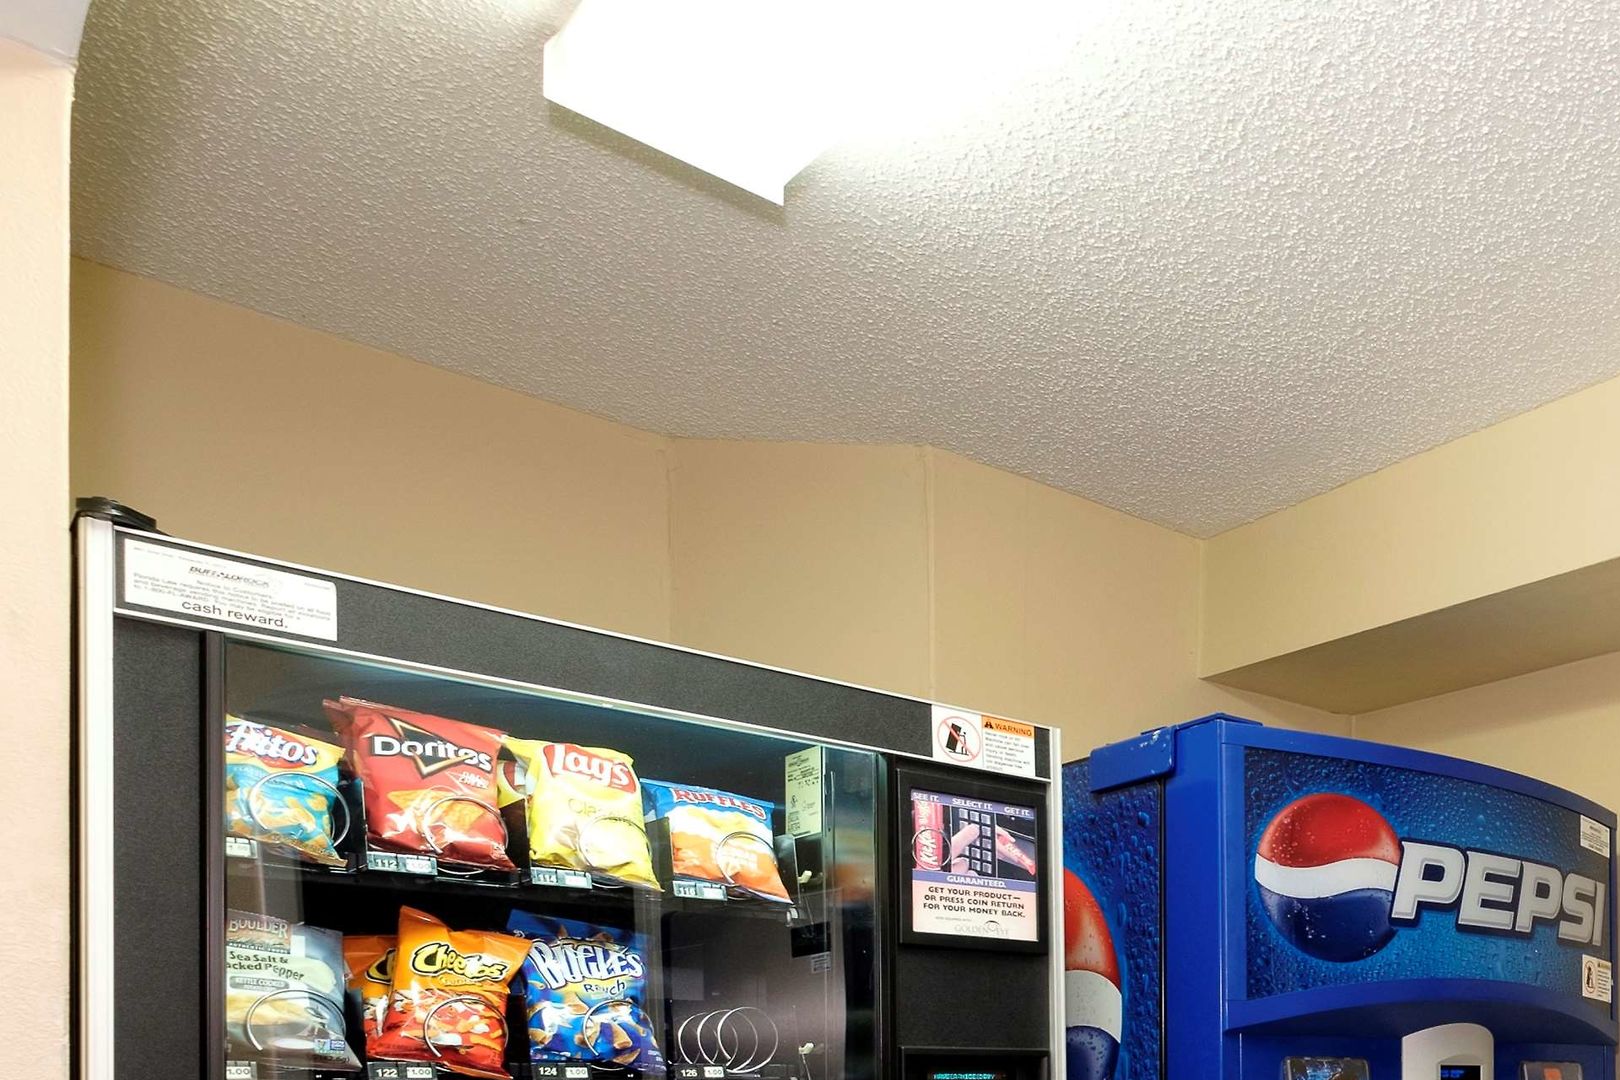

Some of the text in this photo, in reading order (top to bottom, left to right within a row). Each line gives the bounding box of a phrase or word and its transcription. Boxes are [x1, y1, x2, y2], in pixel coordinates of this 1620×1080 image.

[182, 601, 222, 616] cash
[228, 610, 288, 629] reward.
[995, 723, 1032, 736] WARNING
[372, 735, 492, 773] Doritos
[912, 792, 930, 801] SEE
[672, 788, 766, 819] RUFFLES
[952, 798, 982, 810] SELECT
[1004, 806, 1019, 815] GET
[376, 859, 397, 869] 112
[947, 875, 1007, 889] GUARANTEED.
[928, 886, 944, 894] GET
[947, 888, 971, 897] YOUR
[1391, 841, 1606, 946] PEPSI
[924, 894, 937, 902] OR
[939, 896, 965, 904] PRESS
[990, 901, 1025, 910] RETURN
[923, 902, 1026, 918] FOR YOUR MONEY BACK.
[230, 951, 250, 961] Sea
[253, 954, 276, 963] Salt
[411, 942, 509, 982] Cheetos
[227, 961, 305, 981] acked Pepper
[530, 940, 644, 989] BUGLES
[376, 1068, 398, 1077] 122
[539, 1067, 557, 1076] 124
[681, 1069, 698, 1077] 126
